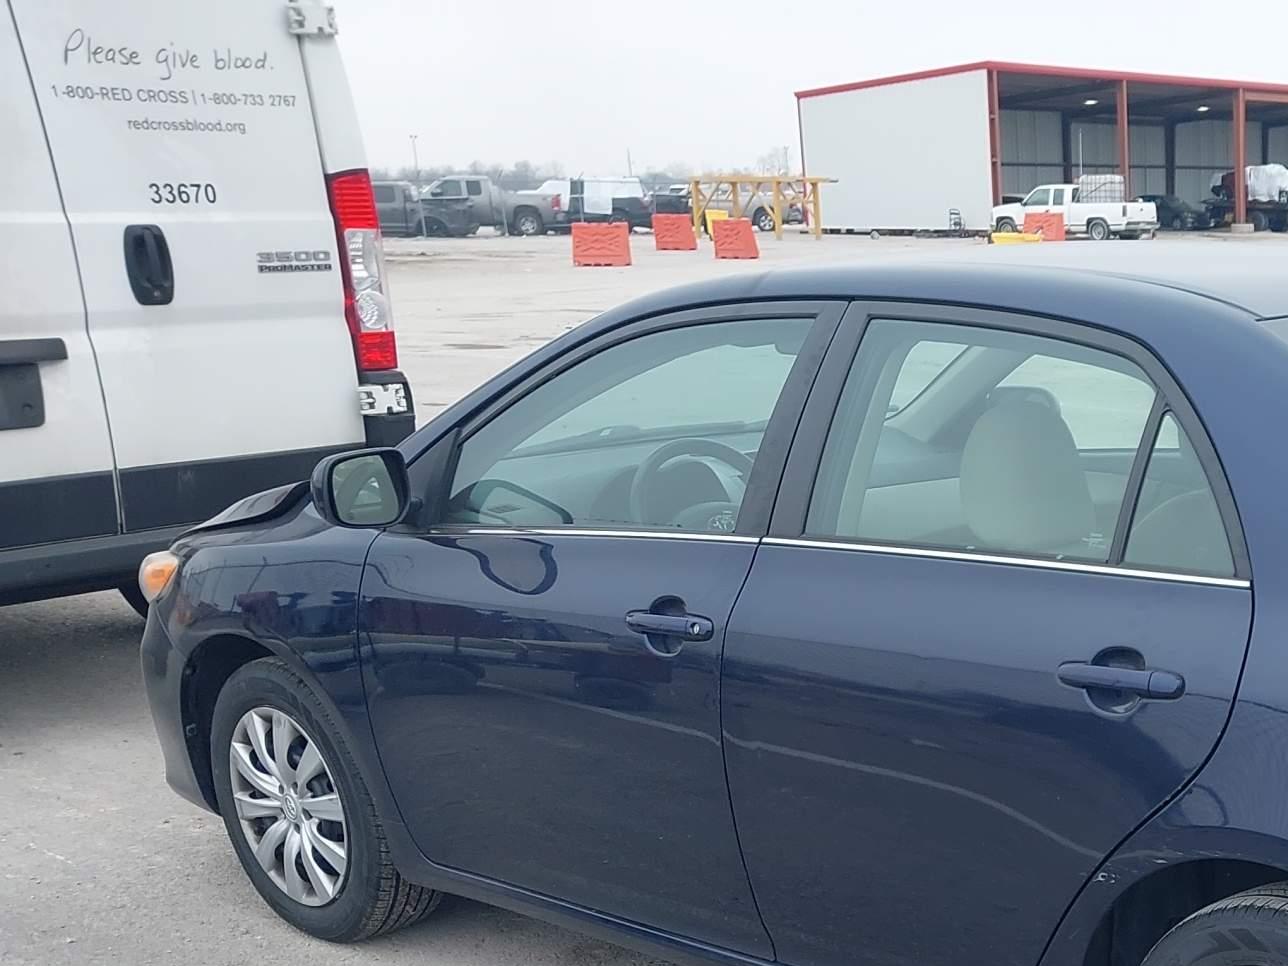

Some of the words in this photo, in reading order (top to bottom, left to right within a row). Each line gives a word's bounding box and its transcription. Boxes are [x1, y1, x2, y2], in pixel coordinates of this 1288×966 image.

[64, 28, 142, 66] Please
[155, 41, 201, 81] give
[213, 48, 275, 71] blood.
[137, 88, 190, 104] CROSS
[127, 118, 247, 135] redcrossblood.org
[148, 183, 217, 204] 33670
[256, 250, 331, 263] 3500
